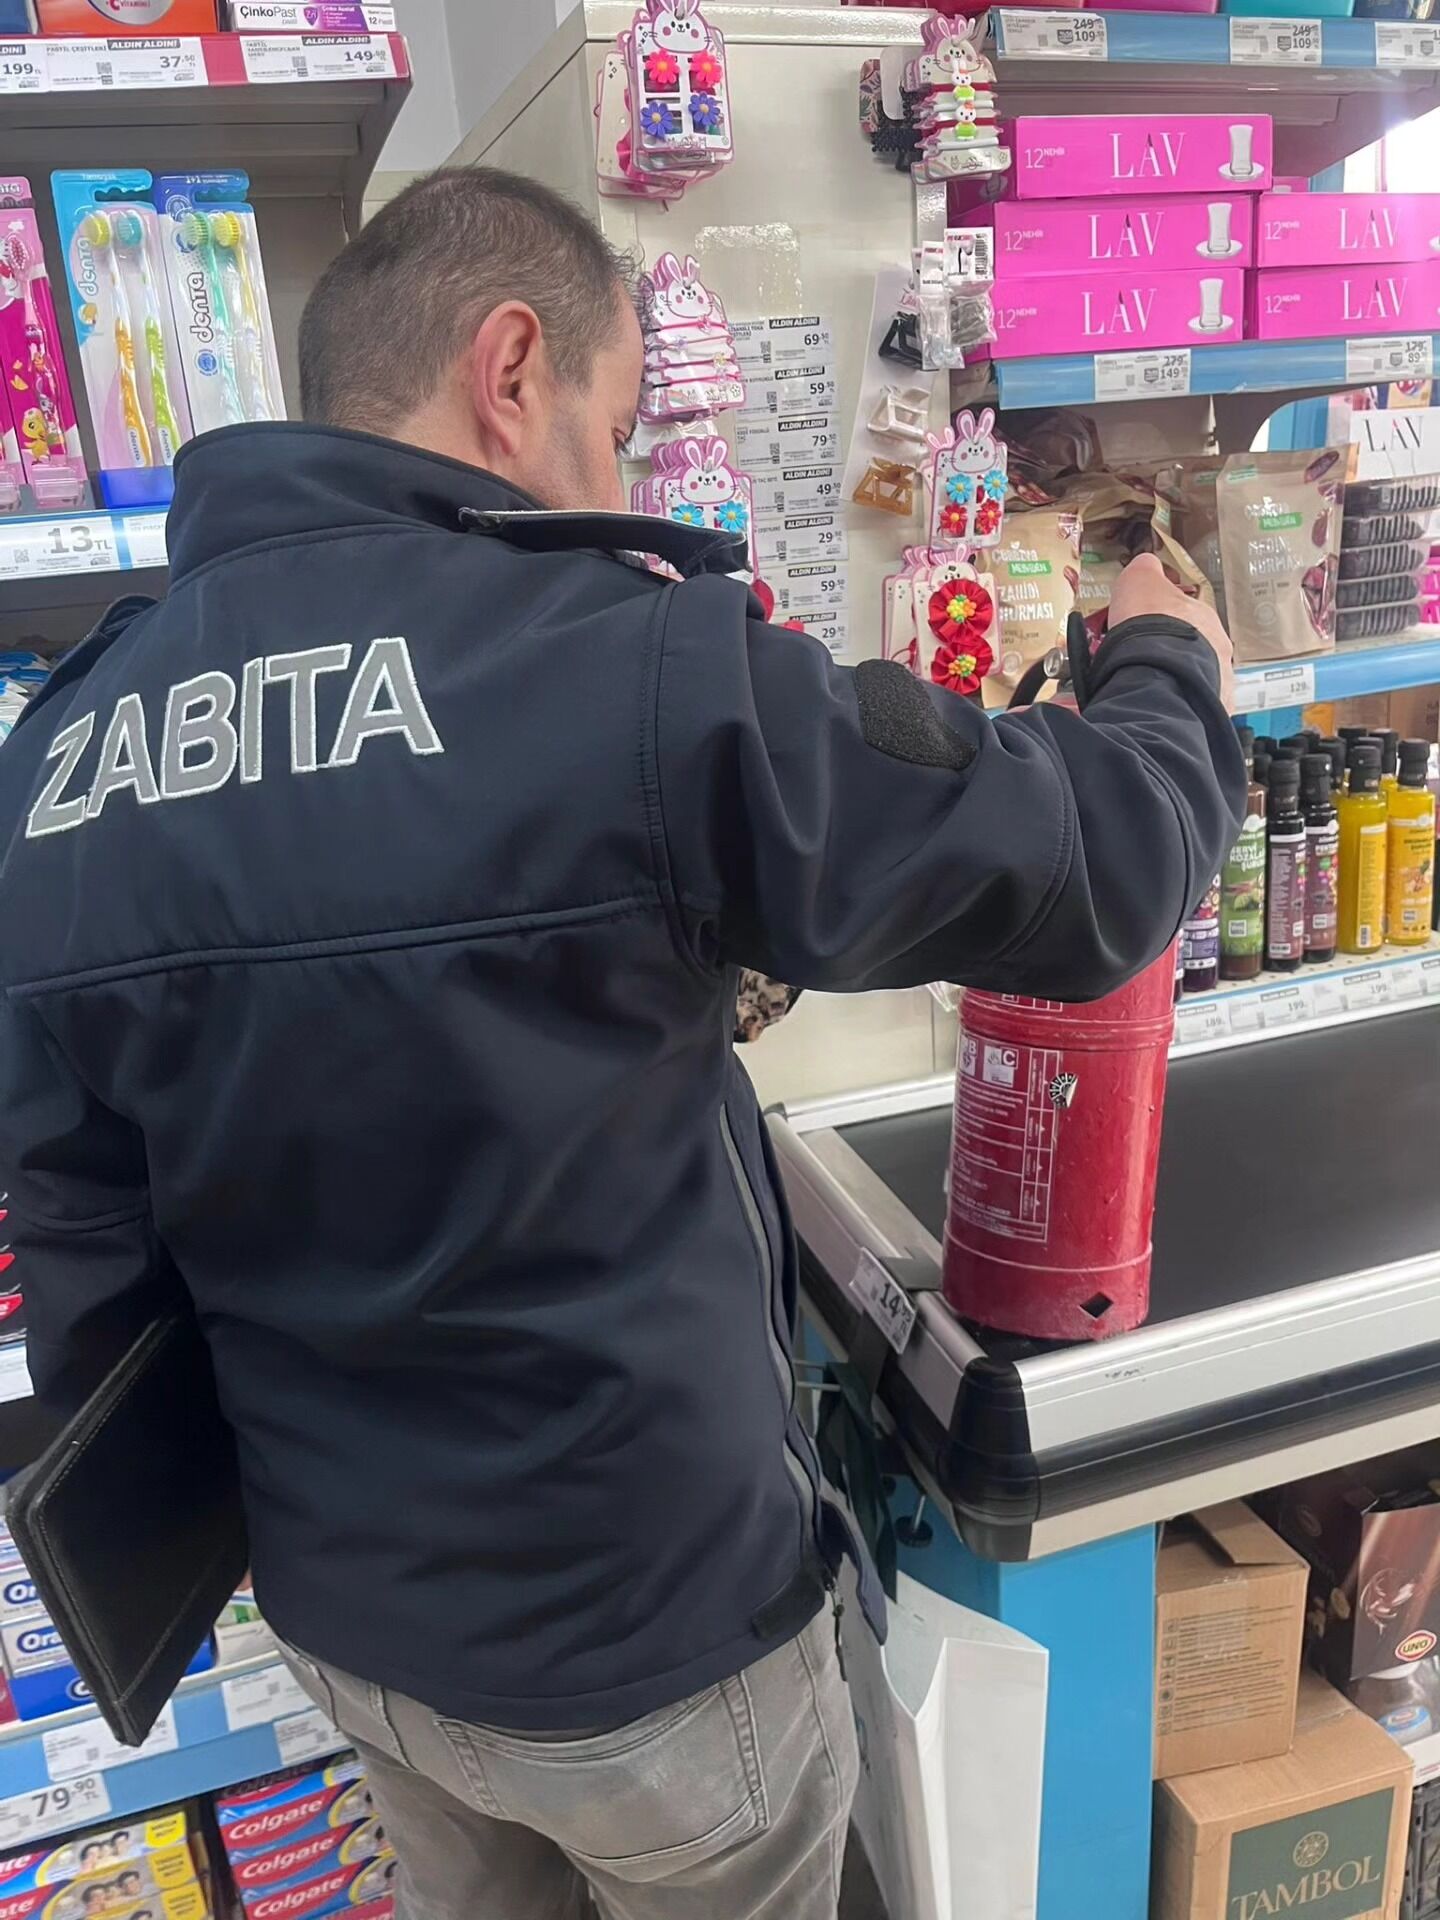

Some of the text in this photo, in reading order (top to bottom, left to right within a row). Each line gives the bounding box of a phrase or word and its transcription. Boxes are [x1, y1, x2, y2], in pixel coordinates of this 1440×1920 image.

[240, 5, 297, 19] ÇinkoPast
[3, 63, 34, 75] 199
[1109, 132, 1187, 178] LAV
[1087, 211, 1166, 260] LAV
[1338, 207, 1402, 250] LAV
[1081, 288, 1157, 336] LAV
[1341, 277, 1409, 321] LAV
[47, 526, 94, 554] 13
[25, 637, 445, 838] ZABITA
[1003, 1050, 1016, 1066] C
[1402, 1639, 1428, 1653] UNO
[229, 1799, 324, 1840] Colgate
[242, 1838, 335, 1878] Colgate
[254, 1875, 345, 1918] Colgate
[1231, 1856, 1381, 1920] TAMBOL
